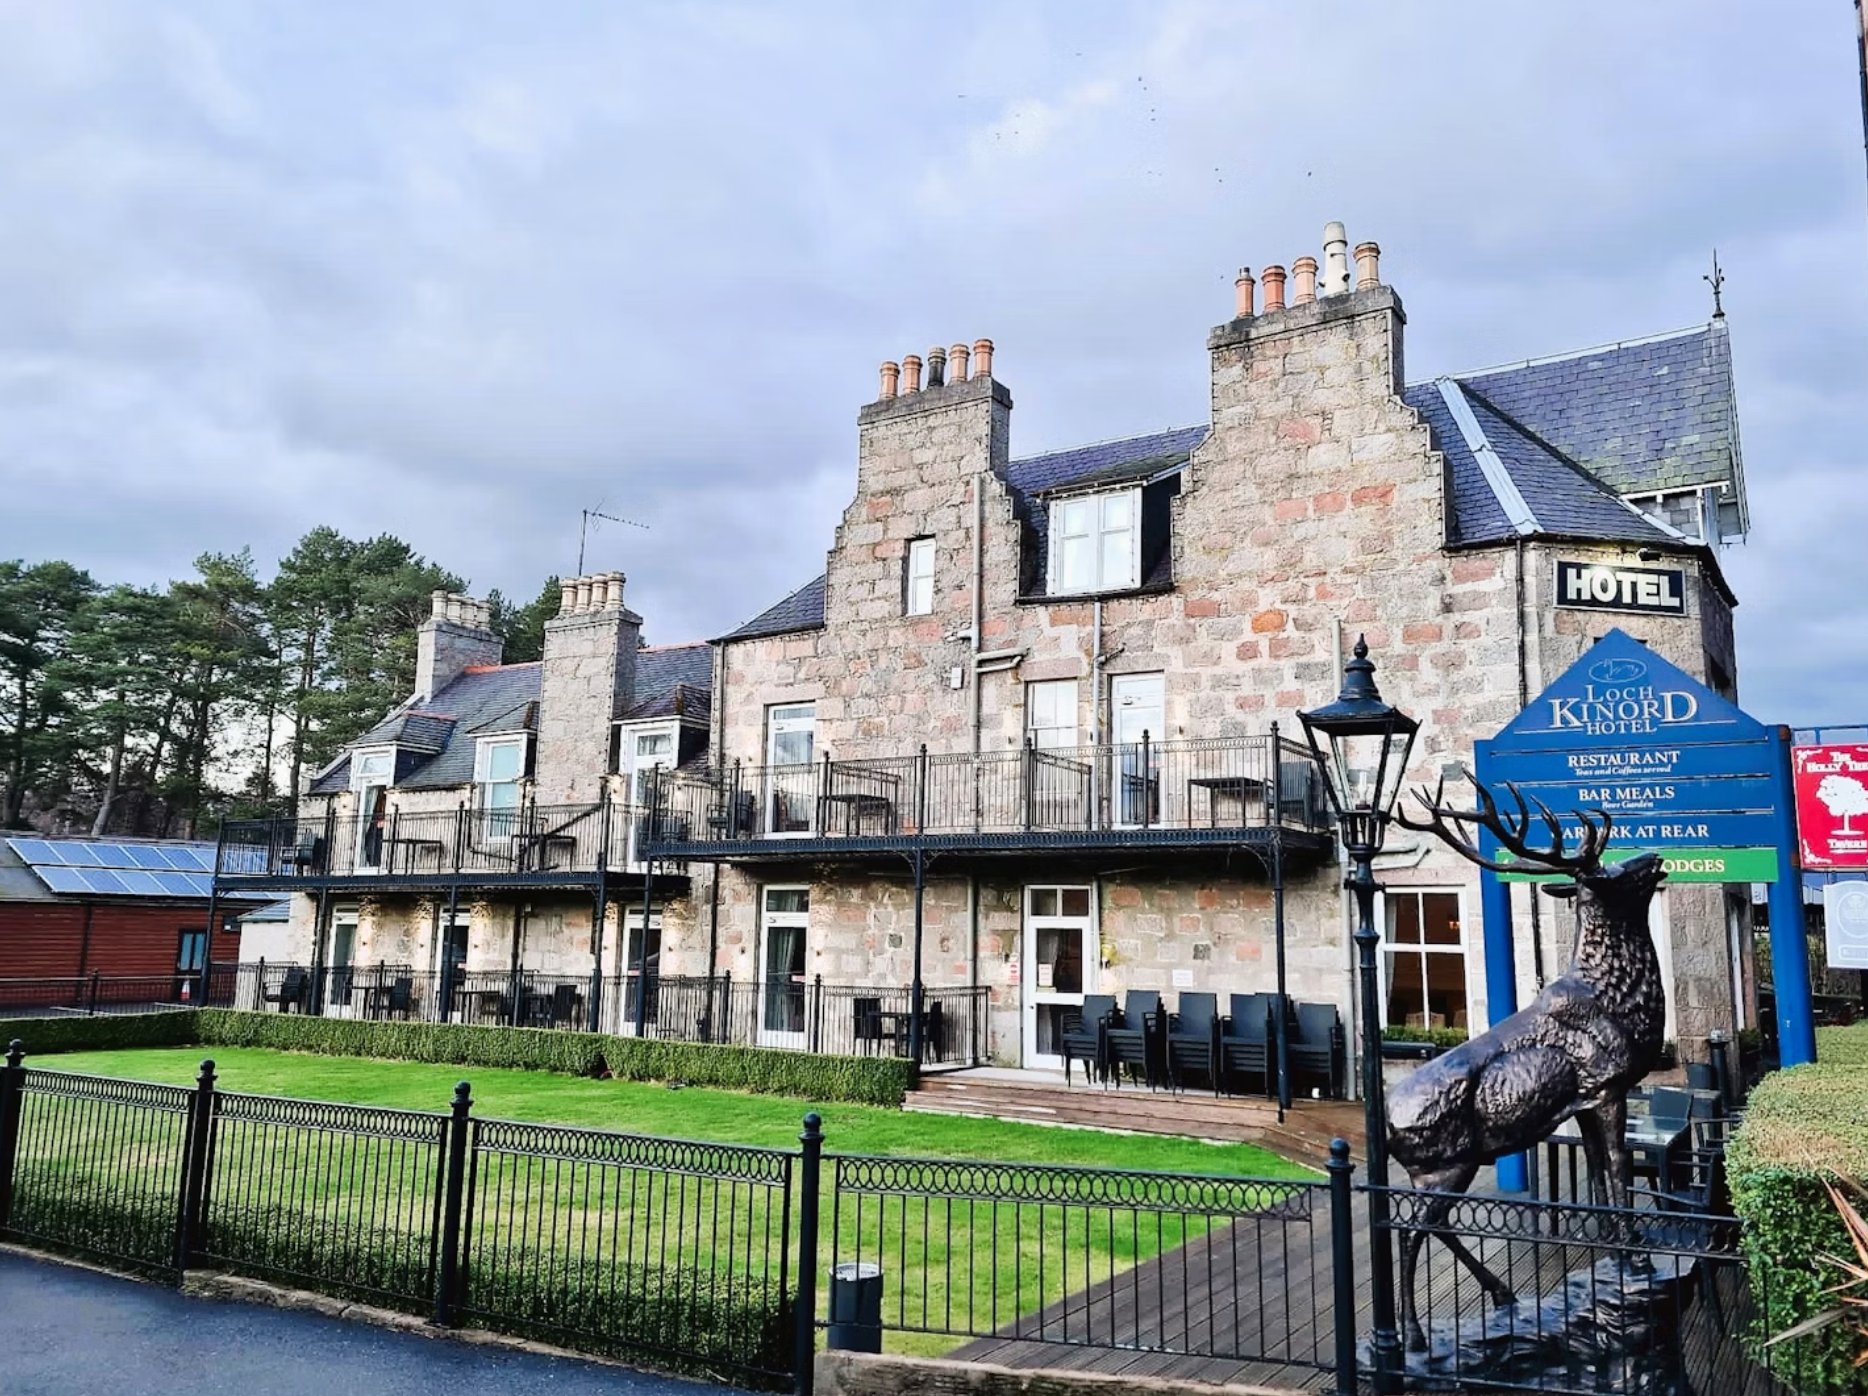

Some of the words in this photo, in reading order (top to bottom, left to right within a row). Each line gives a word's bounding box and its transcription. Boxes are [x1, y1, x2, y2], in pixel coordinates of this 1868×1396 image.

[1567, 566, 1680, 607] HOTEL
[1584, 685, 1654, 702] LOCH
[1548, 691, 1698, 728] KINORD
[1586, 720, 1657, 735] HOTEL
[1568, 751, 1680, 767] RESTAURANT
[1579, 789, 1611, 800] BAR
[1616, 786, 1675, 799] MEALS
[1551, 826, 1585, 839] AR
[1635, 826, 1658, 838] AT
[1661, 824, 1710, 837] REAR
[1651, 859, 1725, 873] ODGES
